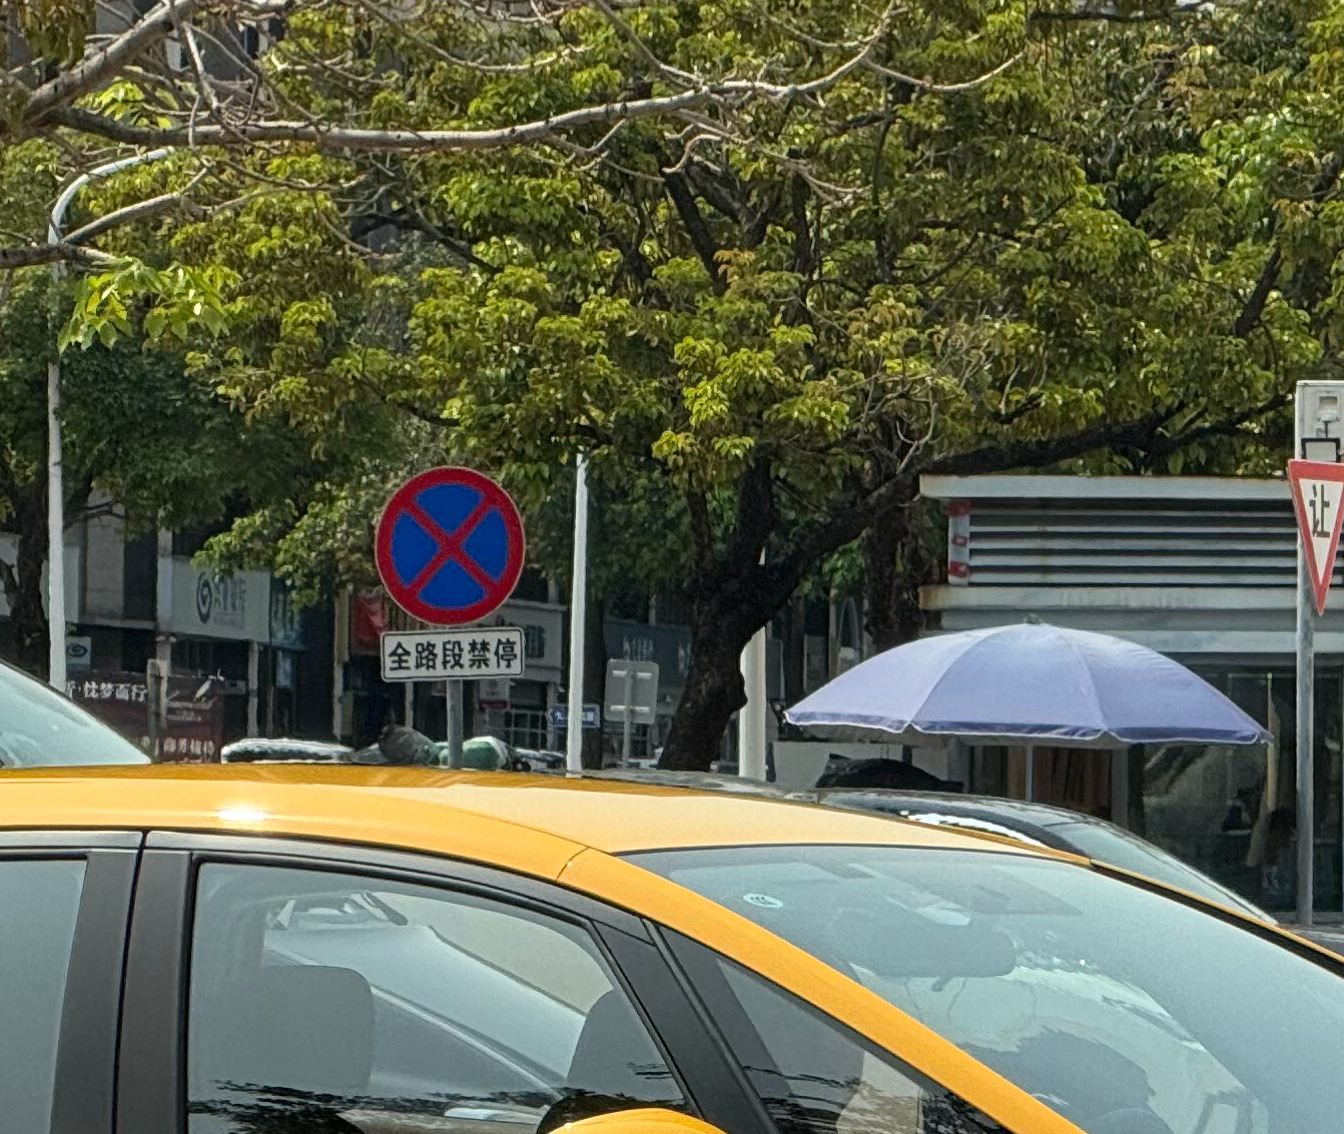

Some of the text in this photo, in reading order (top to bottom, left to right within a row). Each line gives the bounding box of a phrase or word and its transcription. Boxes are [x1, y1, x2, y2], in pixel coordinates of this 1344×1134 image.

[1309, 484, 1331, 538] 让
[388, 637, 518, 671] 全路段禁停
